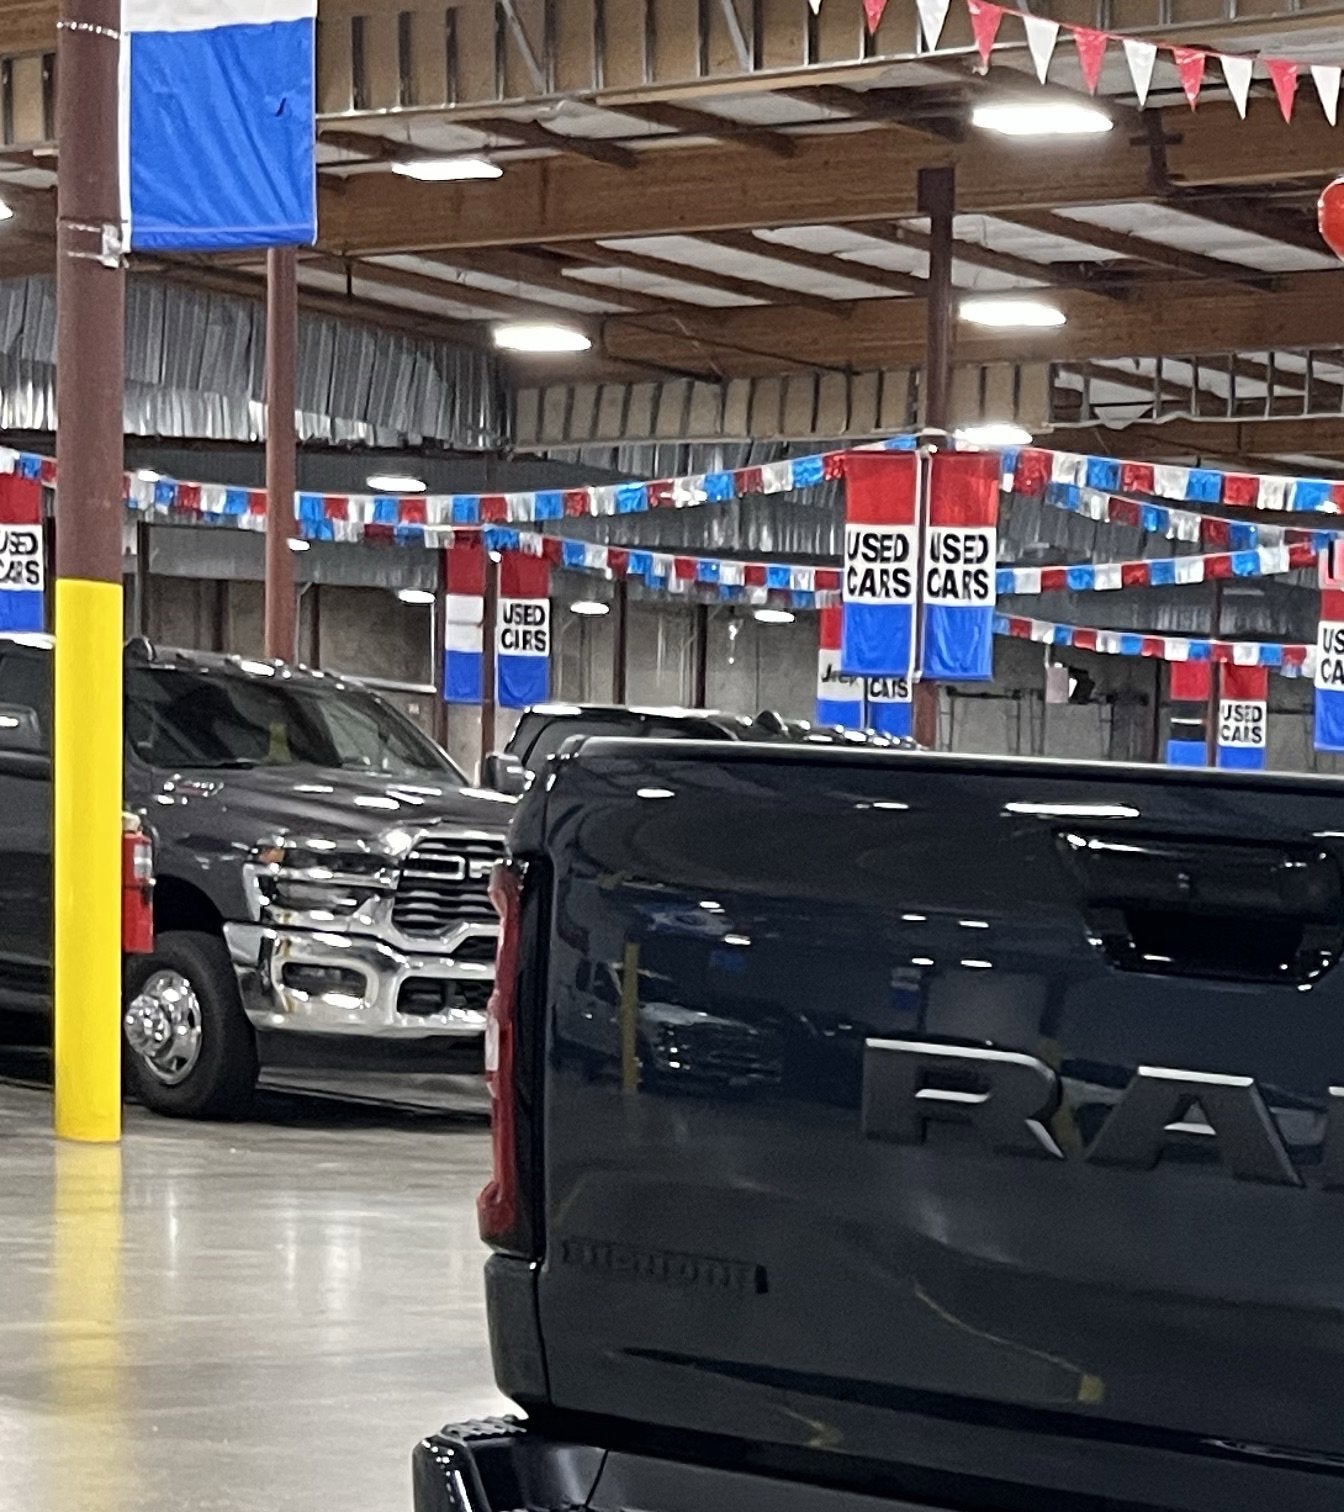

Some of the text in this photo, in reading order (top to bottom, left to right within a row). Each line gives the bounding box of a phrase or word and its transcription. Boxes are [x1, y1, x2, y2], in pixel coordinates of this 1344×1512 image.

[847, 531, 909, 564] USED
[930, 531, 989, 565] USED
[847, 566, 912, 599] CARS
[926, 566, 989, 601] CARS
[502, 602, 546, 627] USED
